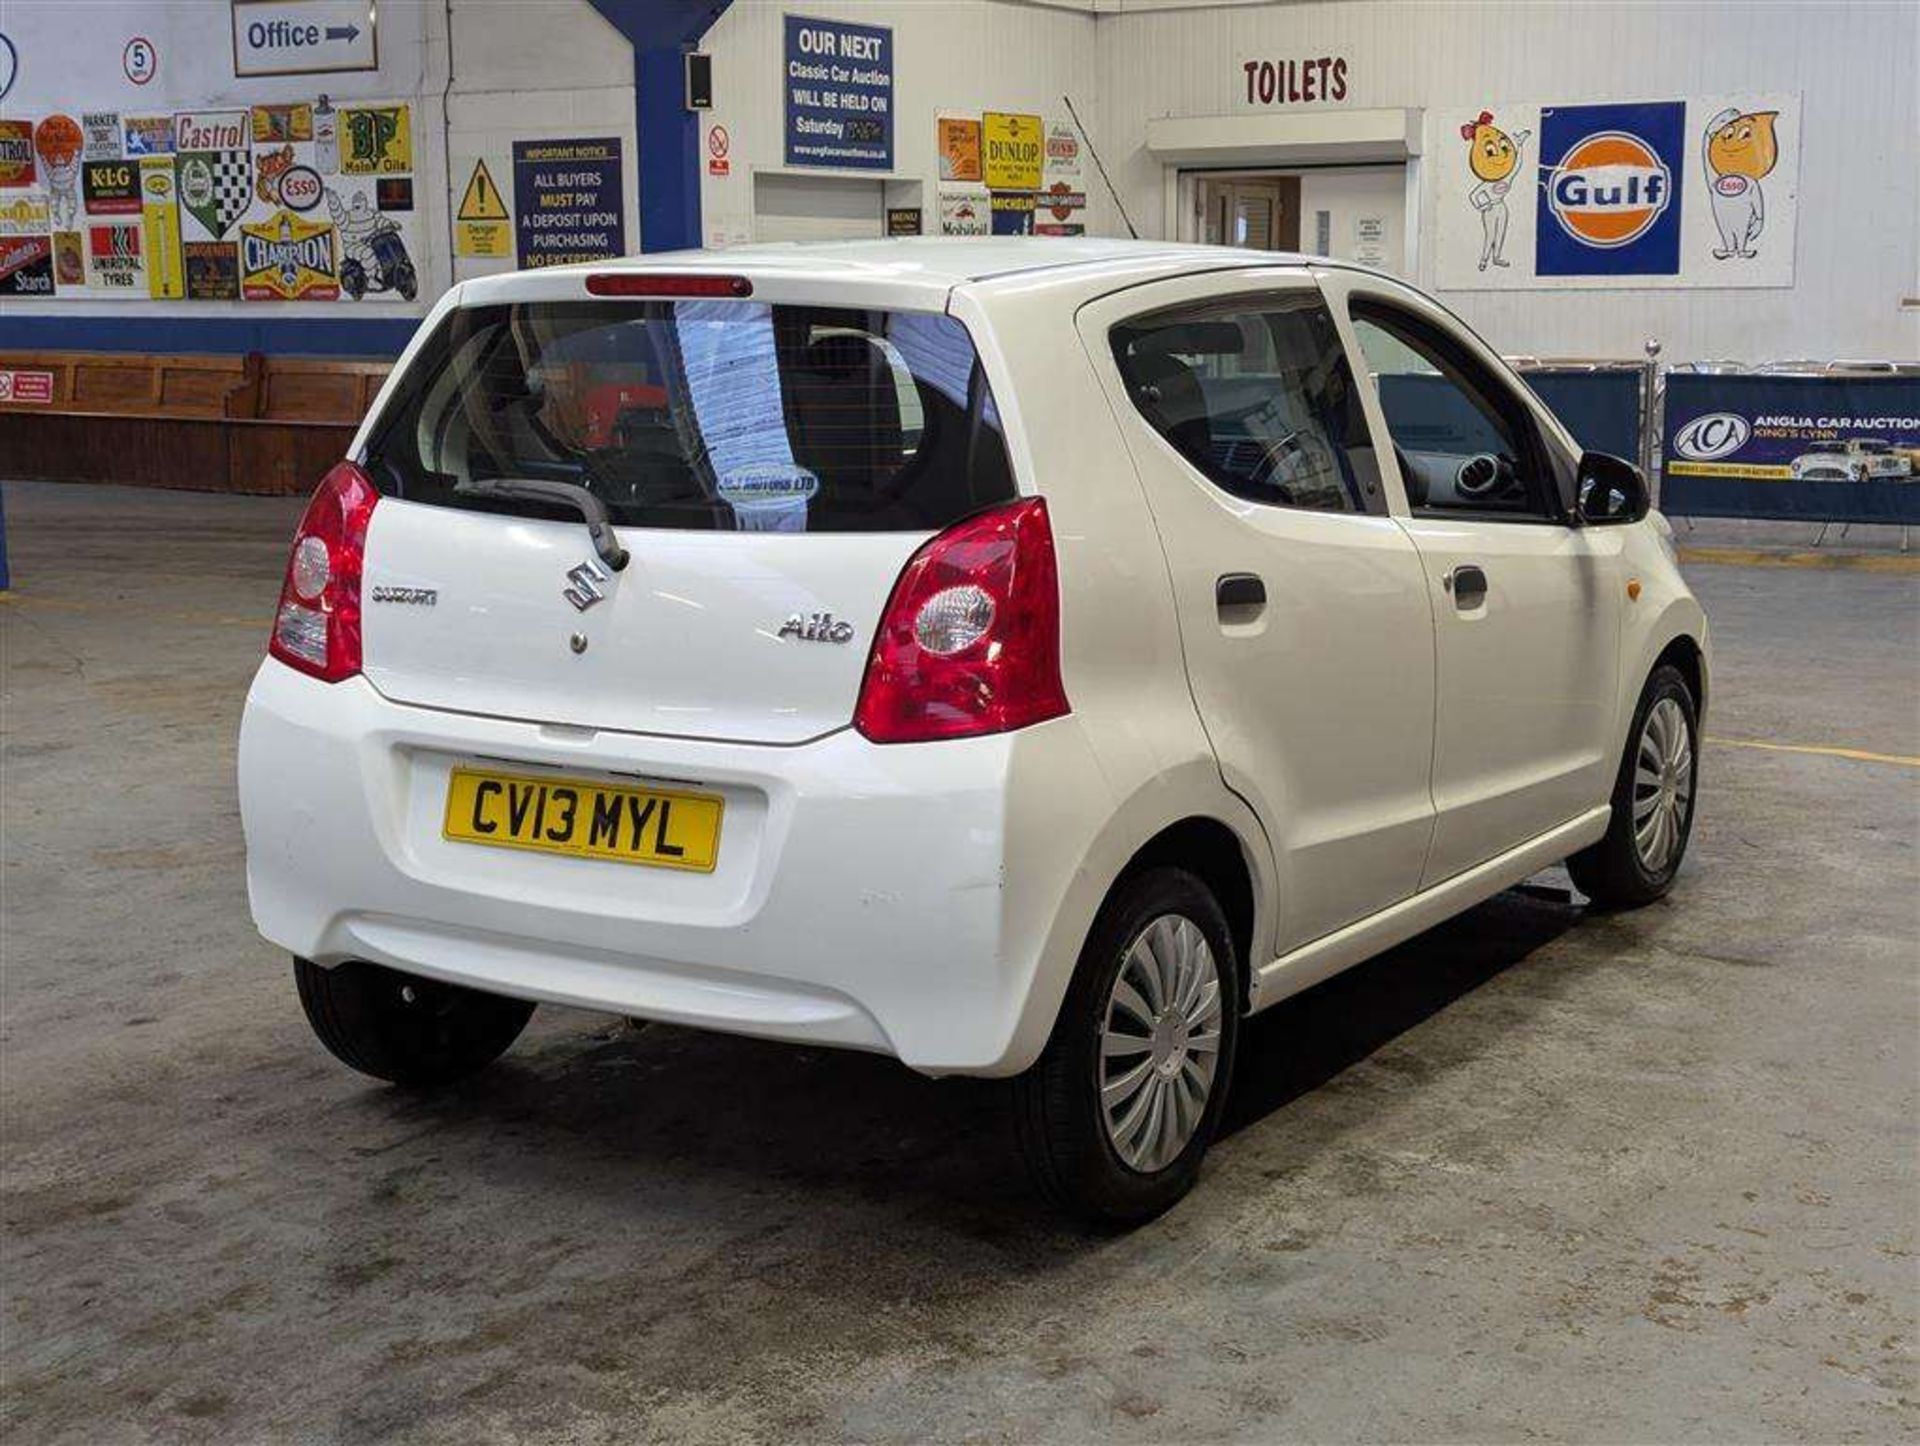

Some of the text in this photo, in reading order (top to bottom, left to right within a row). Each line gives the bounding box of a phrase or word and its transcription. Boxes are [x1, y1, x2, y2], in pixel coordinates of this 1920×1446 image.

[248, 22, 319, 49] Office
[799, 29, 882, 61] OUR NEXT
[134, 44, 144, 67] 5
[790, 60, 890, 86] Classic Car Auction
[1244, 58, 1348, 104] TOILETS
[793, 89, 888, 112] WILL BE HELD ON
[180, 116, 246, 149] Castrol
[796, 116, 844, 139] Saturday
[989, 140, 1039, 162] DUNLOP
[534, 172, 602, 187] ALL BUYERS
[1556, 175, 1664, 206] Gulf
[540, 193, 597, 207] MUST PAY
[523, 213, 617, 228] A DEPOSIT UPON
[533, 232, 609, 248] PURCHASING
[245, 235, 332, 273] CHAMPION
[527, 255, 544, 268] NO
[15, 269, 51, 291] Starch
[103, 272, 134, 287] TYRES
[1754, 416, 1814, 428] ANGLIA
[1817, 417, 1850, 429] CAR
[1679, 419, 1740, 452] ACA
[1801, 430, 1838, 440] LYNN
[795, 476, 815, 489] LTD
[372, 586, 438, 607] SUZUKI
[779, 613, 853, 645] Alto
[472, 780, 684, 856] CV13 MYL
